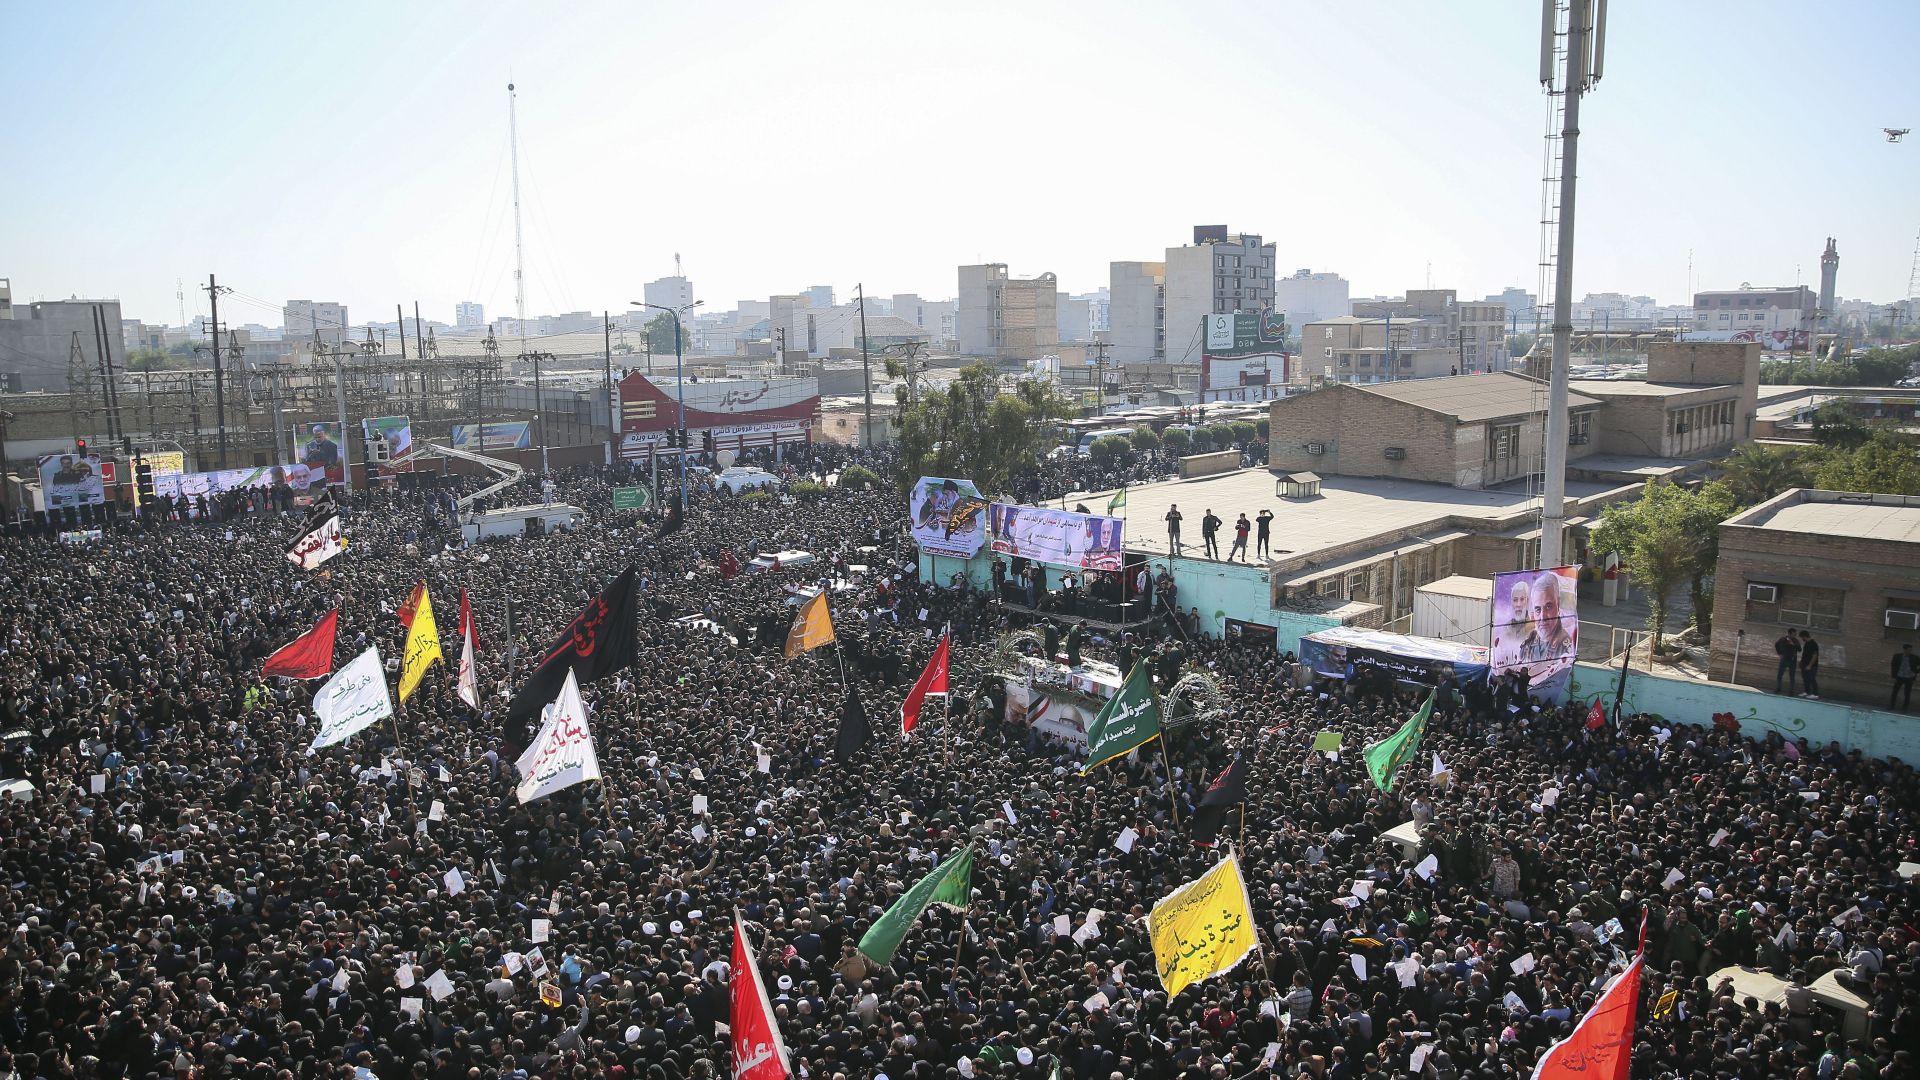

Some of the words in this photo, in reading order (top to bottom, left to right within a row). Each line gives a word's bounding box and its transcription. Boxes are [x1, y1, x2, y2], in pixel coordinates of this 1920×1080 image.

[1354, 656, 1375, 665] العباس
[1389, 662, 1406, 672] هیئت
[1407, 665, 1427, 676] موکب
